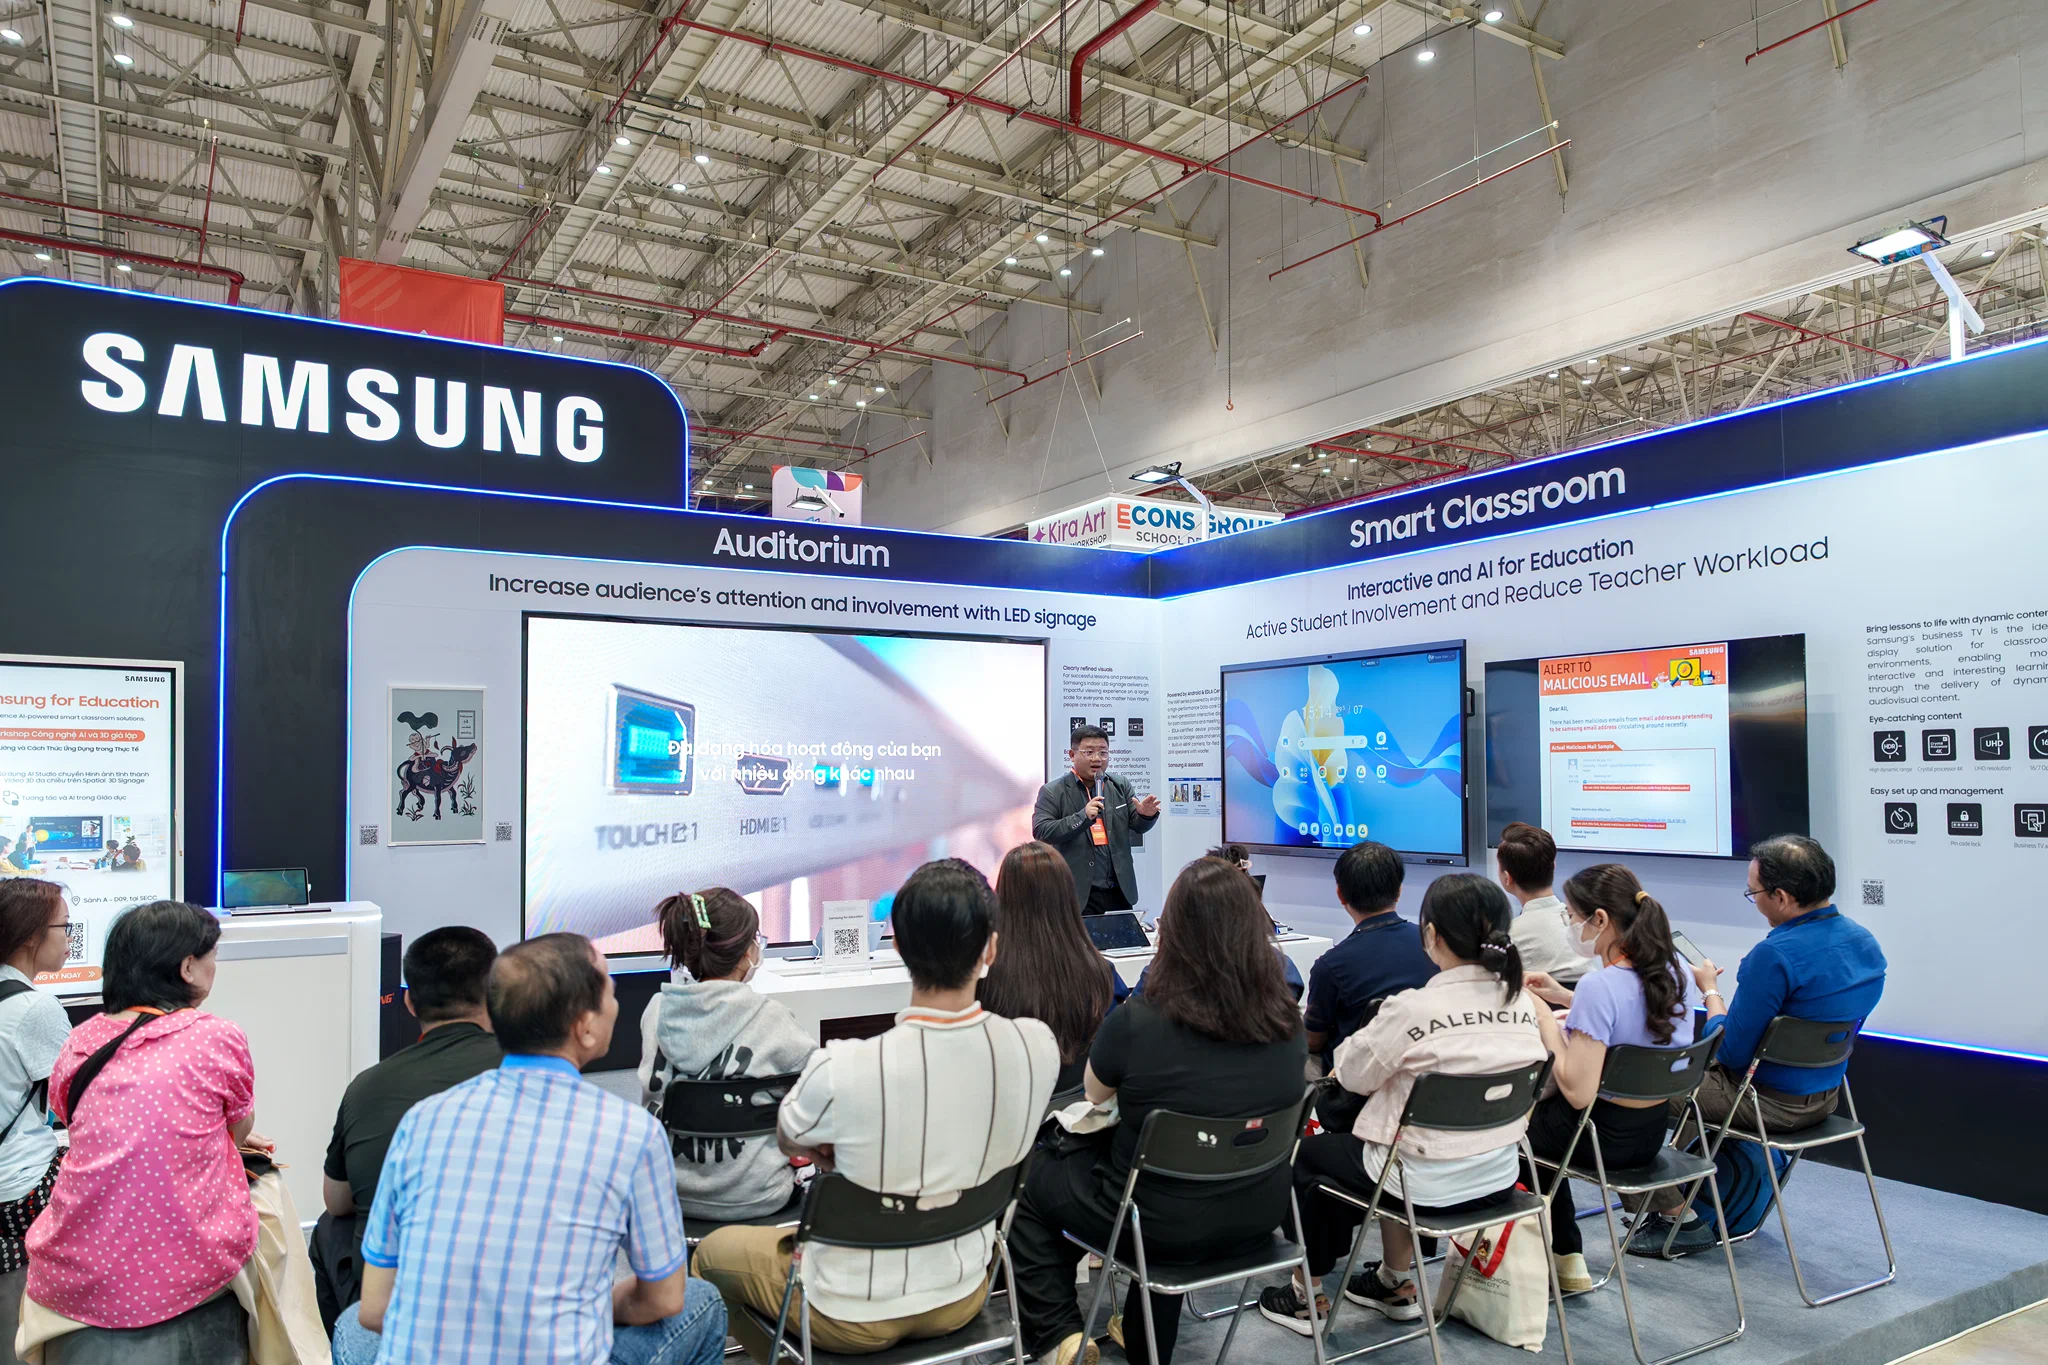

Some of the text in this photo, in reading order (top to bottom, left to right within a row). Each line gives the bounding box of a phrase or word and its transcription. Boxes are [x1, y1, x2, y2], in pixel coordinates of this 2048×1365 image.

[81, 332, 605, 463] SAMSUNG
[1350, 467, 1626, 548] Smart Classroom
[1048, 507, 1107, 543] Kira Art
[1117, 504, 1274, 534] ECONS GROU
[1071, 534, 1107, 547] ORKSHOP
[1136, 531, 1184, 545] SCHOOL
[713, 528, 890, 567] Auditorium
[1348, 538, 1634, 600] Interactive and AI for Education
[1246, 536, 1829, 639] Active Student Involvement and Reduce Teacher Workload
[488, 574, 1096, 630] Increase audience's attention and involvement with LED signage
[1866, 613, 2014, 634] Bring lessons to life with dynamic
[1867, 634, 1915, 645] Samsung's
[1922, 630, 1963, 641] business
[1971, 628, 1983, 636] TV
[2007, 625, 2023, 633] the
[1689, 646, 1724, 656] SAMSUNG
[1867, 648, 1899, 658] display
[1916, 644, 1952, 654] solution
[1971, 641, 1984, 649] for
[1958, 653, 2001, 663] enabling
[1543, 661, 1592, 675] ALERT TO
[1868, 666, 2005, 681] interactive and interesting
[125, 675, 166, 683] SAMSUNG
[1543, 672, 1649, 691] MALICIOUS EMAIL
[1869, 678, 2001, 694] through the delivery of
[50, 694, 75, 707] for
[79, 695, 159, 709] Education
[1869, 694, 1960, 706] audiovisual content.
[19, 713, 59, 721] AI-powered
[1302, 705, 1332, 719] 15:14
[1354, 705, 1363, 715] 07
[1869, 712, 1962, 724] Eye-catching content
[31, 730, 54, 739] Công
[56, 731, 77, 740] nghệ
[89, 731, 98, 739] và
[749, 740, 782, 756] hóa
[787, 742, 827, 760] hoạt
[831, 741, 874, 761] động
[878, 741, 908, 757] của
[911, 743, 941, 761] bạn
[701, 765, 726, 780] với
[731, 762, 778, 781] nhiều
[875, 767, 915, 781] nhau
[1871, 788, 1889, 797] Easy
[1907, 789, 1918, 797] up
[1920, 787, 1937, 795] and
[1939, 788, 2004, 797] management
[740, 818, 771, 836] HDMI
[594, 823, 668, 851] TOUCH
